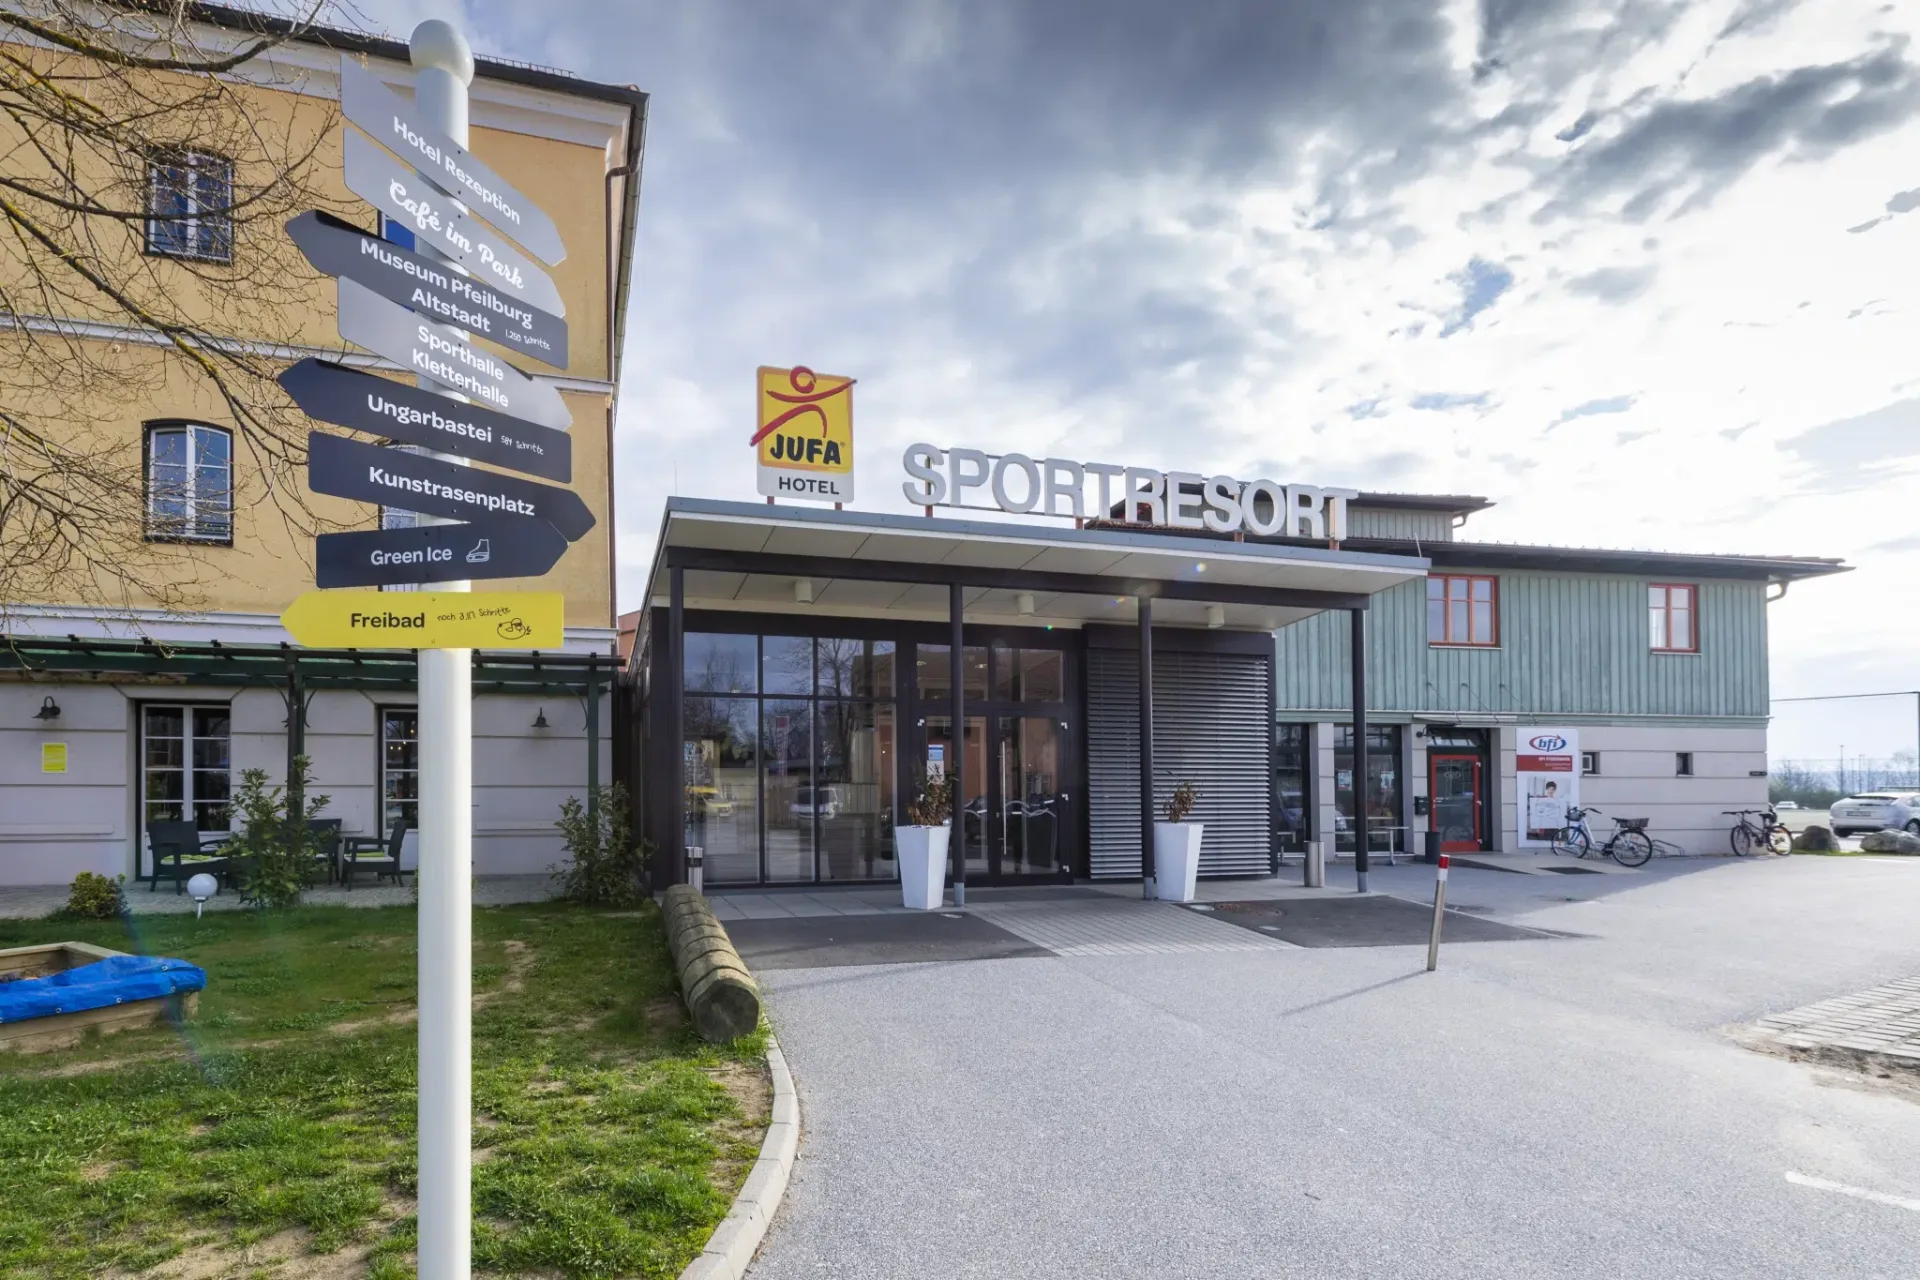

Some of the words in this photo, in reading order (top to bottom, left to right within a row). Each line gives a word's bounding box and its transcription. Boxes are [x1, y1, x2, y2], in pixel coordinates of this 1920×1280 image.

[393, 115, 441, 165] Hotel
[445, 155, 520, 225] Rezeption
[389, 178, 442, 231] Café
[445, 221, 473, 254] im
[478, 242, 525, 290] Park
[361, 238, 448, 290] Museum
[452, 277, 533, 330] Pfeilburg
[412, 287, 492, 333] Altstadt
[505, 329, 522, 342] 1.250
[412, 348, 509, 408] Kletterhalle
[418, 325, 504, 381] Sporthalle
[367, 394, 492, 443] Ungarbastei
[516, 440, 544, 455] Schritte
[770, 433, 841, 465] JUFA
[369, 466, 535, 516] Kunstrasenplatz
[778, 476, 840, 495] HOTEL
[903, 443, 1358, 541] SPORTRESORT
[371, 549, 423, 565] Green
[427, 546, 453, 562] Ice
[351, 612, 425, 628] Freibad
[437, 612, 456, 621] noch
[478, 606, 511, 617] Schritte
[1538, 738, 1558, 752] bfi
